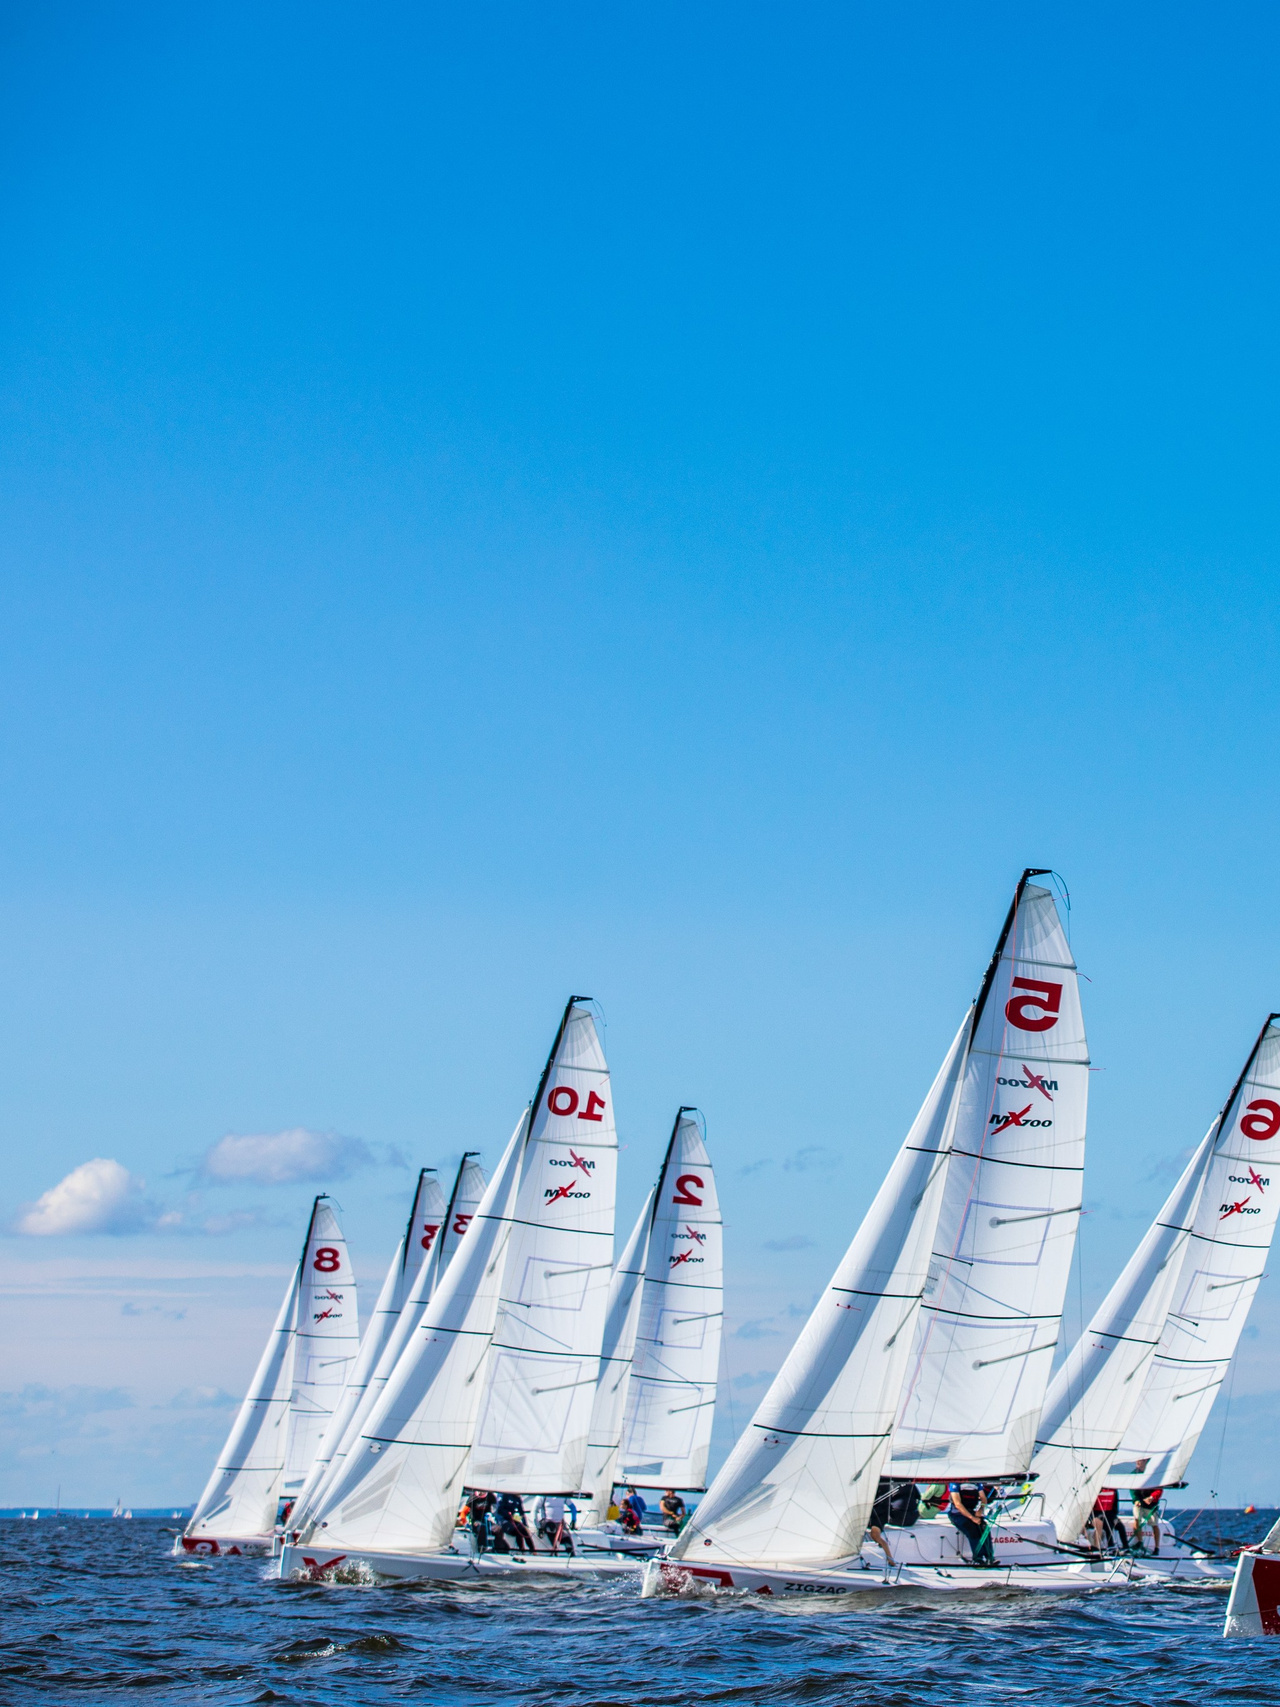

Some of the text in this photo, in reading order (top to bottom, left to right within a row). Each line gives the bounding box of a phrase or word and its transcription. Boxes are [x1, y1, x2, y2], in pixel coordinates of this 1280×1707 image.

[989, 1103, 1053, 1136] MX700
[543, 1180, 591, 1206] MX700
[1219, 1196, 1261, 1220] MX700
[784, 1582, 848, 1595] ZIGZAG
